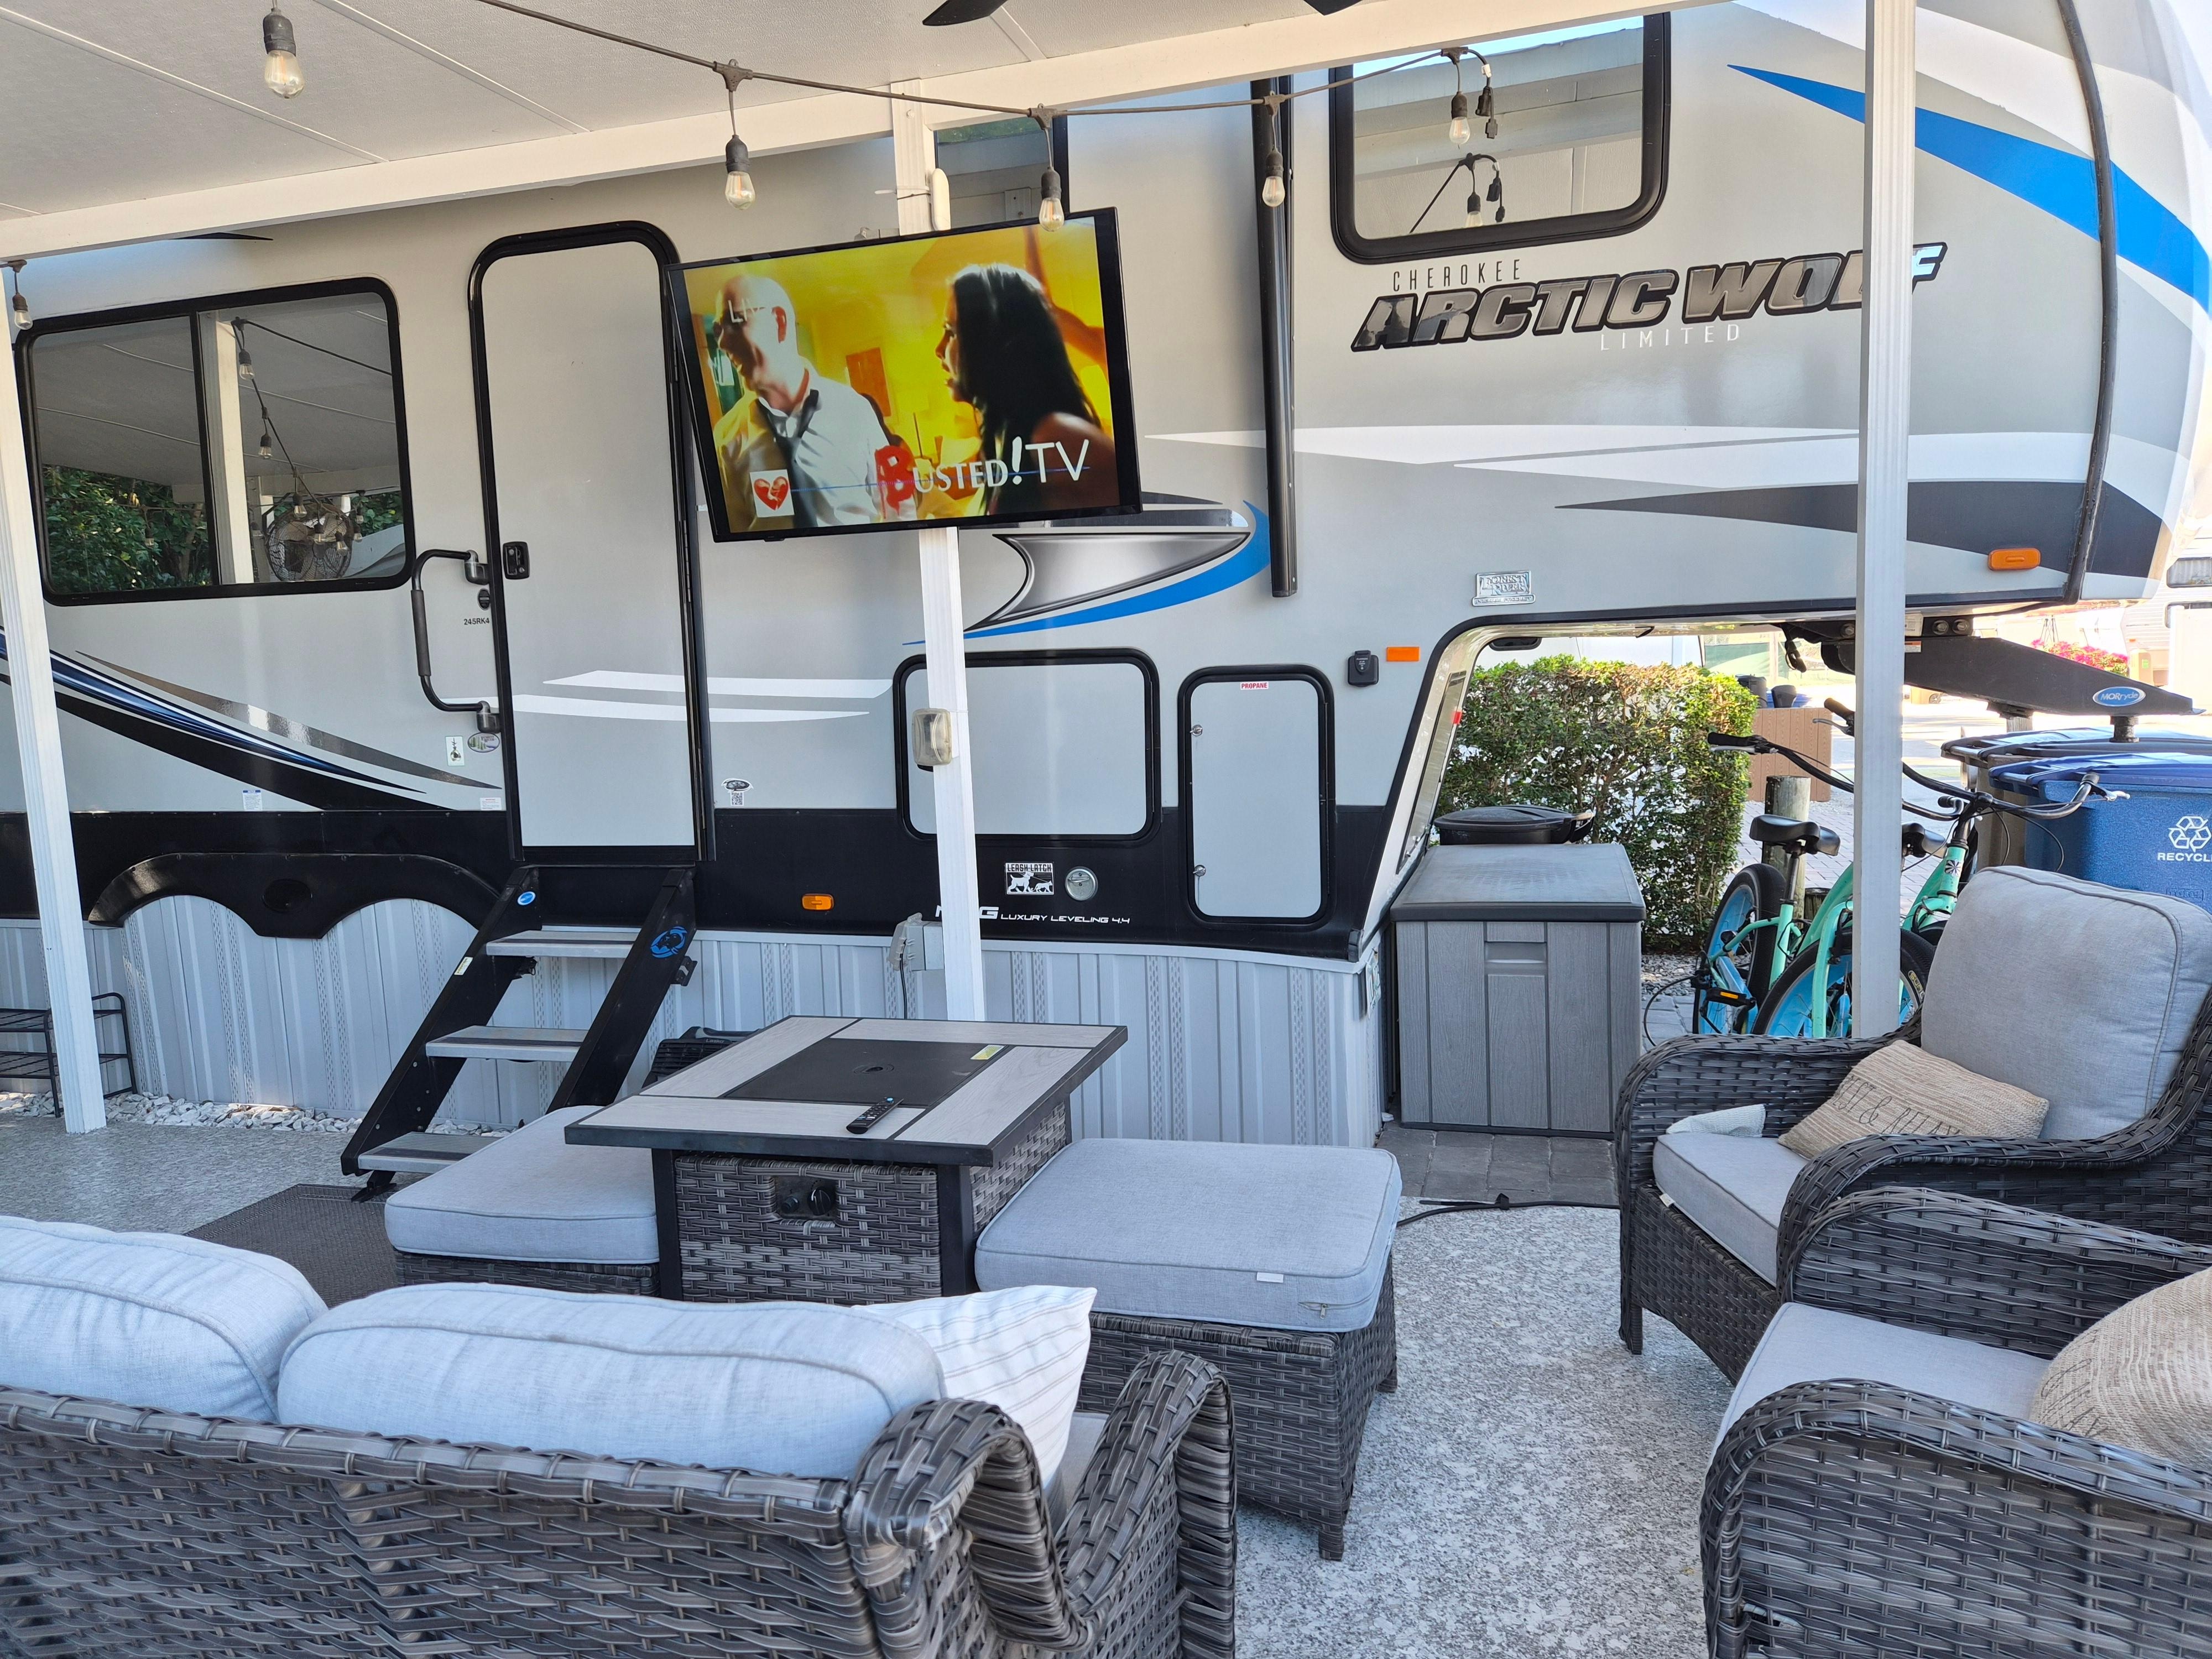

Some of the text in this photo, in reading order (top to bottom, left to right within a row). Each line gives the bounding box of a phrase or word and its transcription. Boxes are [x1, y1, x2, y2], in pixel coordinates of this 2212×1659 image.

[1393, 259, 1521, 292] CHEROKEE
[1350, 269, 1679, 352] ARCTIC
[1600, 324, 1740, 351] LIMITED
[463, 617, 491, 625] 245RK4
[2100, 691, 2139, 701] MORryde
[2157, 852, 2212, 862] RECYCL
[1001, 913, 1047, 922] LUXURY
[1051, 915, 1108, 924] LEVELING
